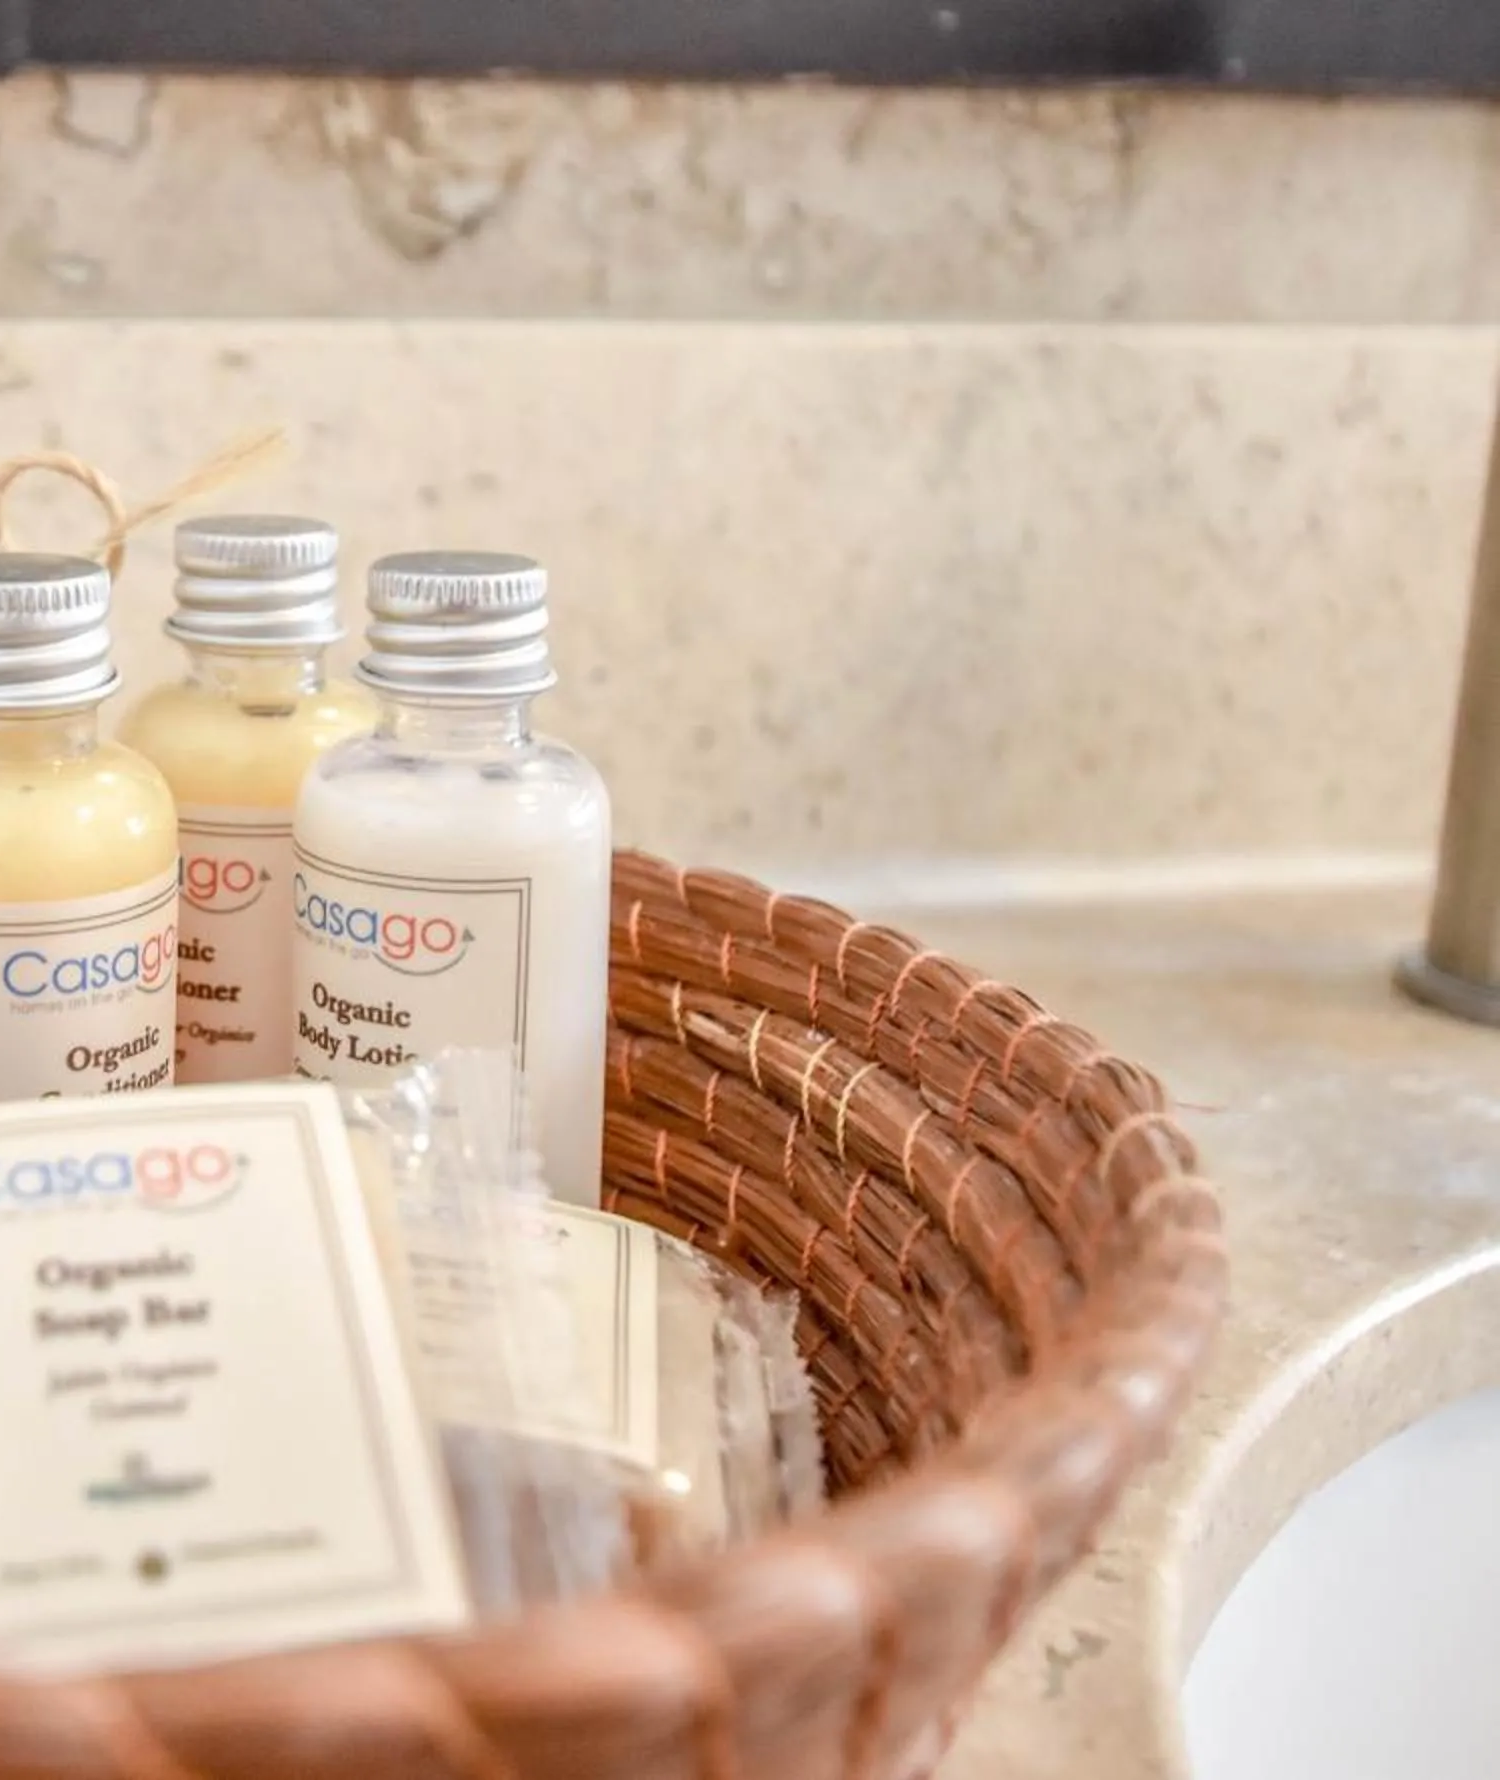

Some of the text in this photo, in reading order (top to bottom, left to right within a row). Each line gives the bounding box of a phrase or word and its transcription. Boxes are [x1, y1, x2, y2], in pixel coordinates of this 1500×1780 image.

[294, 872, 456, 960] Casago
[2, 924, 177, 998] Casago
[312, 982, 411, 1029] Organic
[66, 1025, 160, 1073] Organic
[299, 1011, 342, 1060] Body
[36, 1247, 195, 1292] Organic
